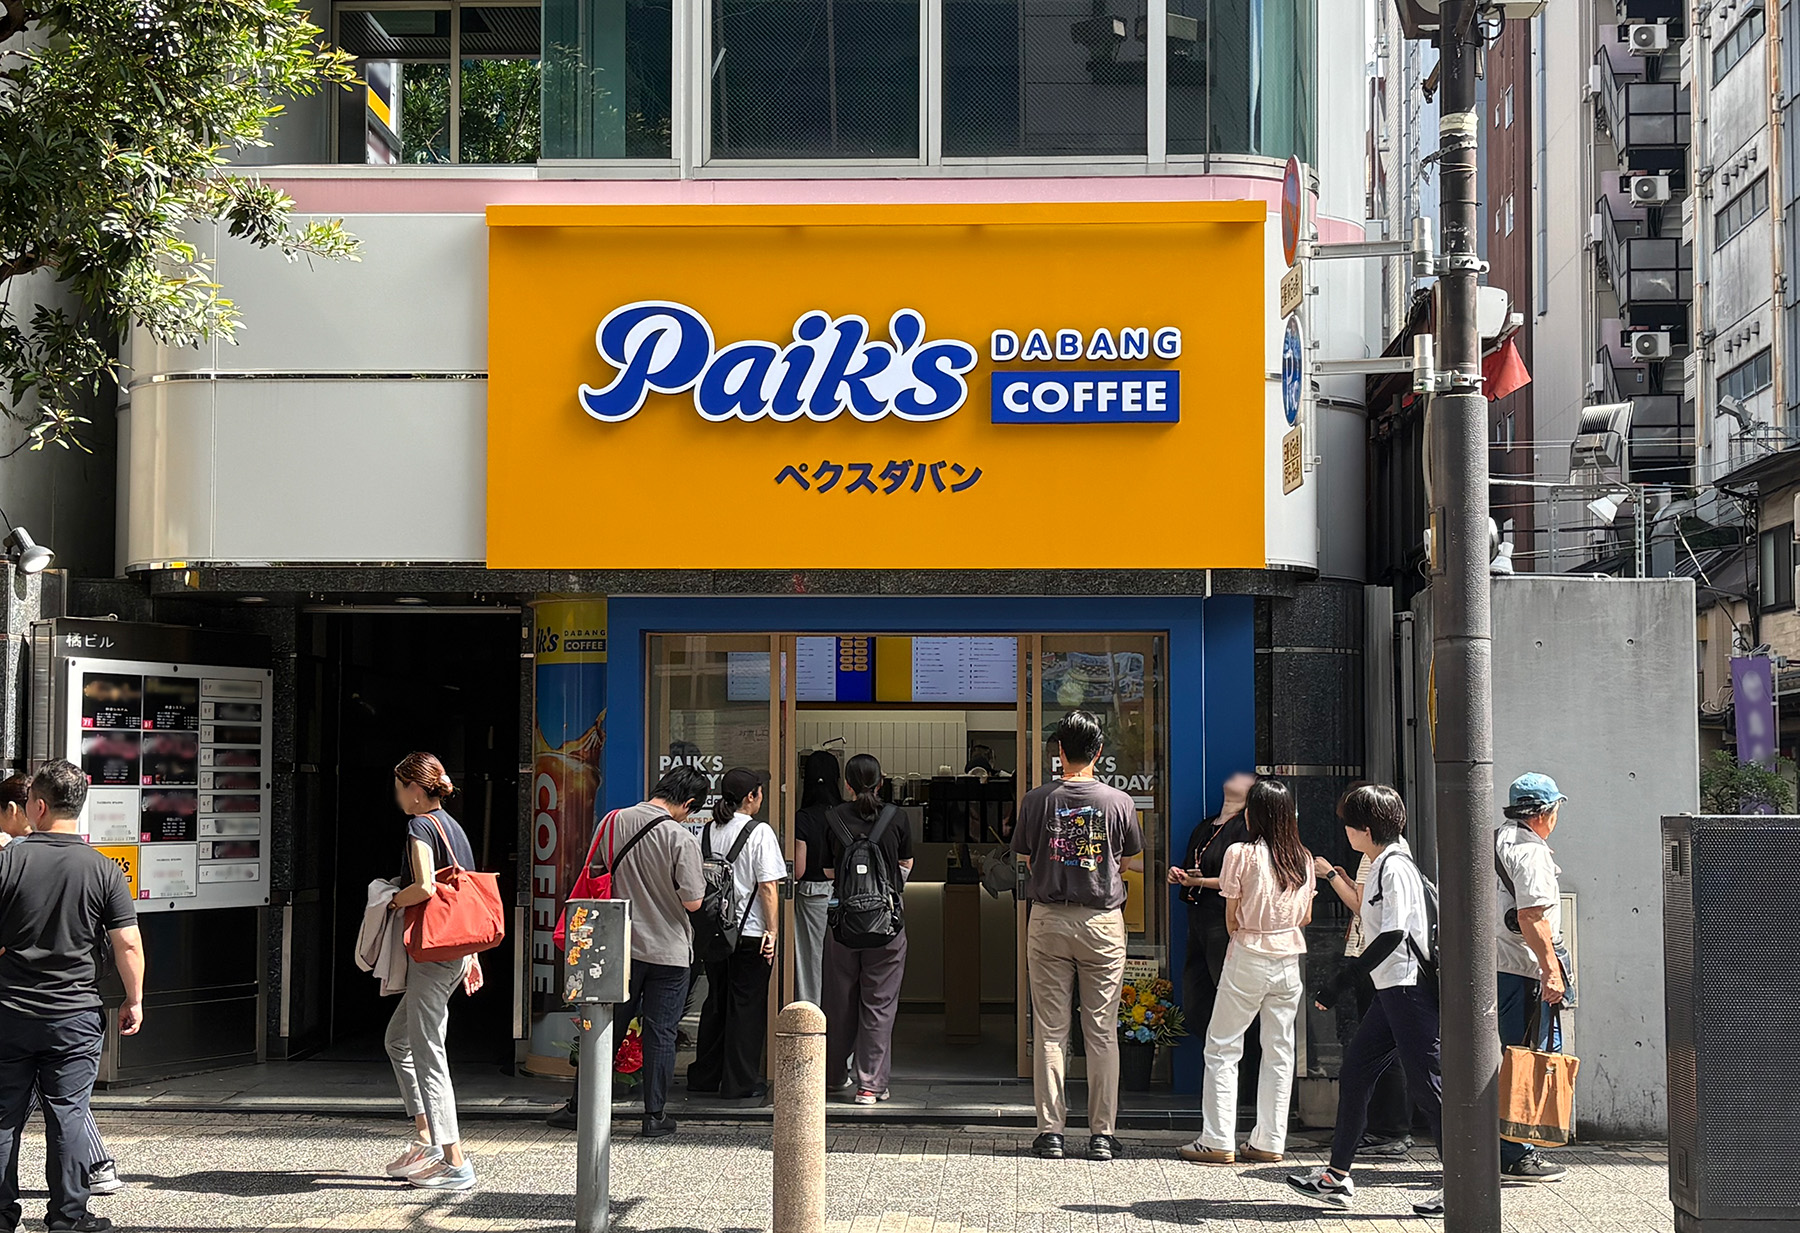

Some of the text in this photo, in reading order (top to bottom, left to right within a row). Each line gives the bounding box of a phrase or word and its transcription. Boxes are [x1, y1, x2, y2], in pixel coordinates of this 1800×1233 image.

[579, 301, 977, 421] Paik's
[990, 327, 1181, 361] DABANG
[1002, 381, 1167, 413] COFFEE
[775, 460, 983, 494] ペクスダバン
[566, 641, 603, 650] COFFEE
[1052, 756, 1116, 772] P'S
[533, 773, 558, 994] COFFEE
